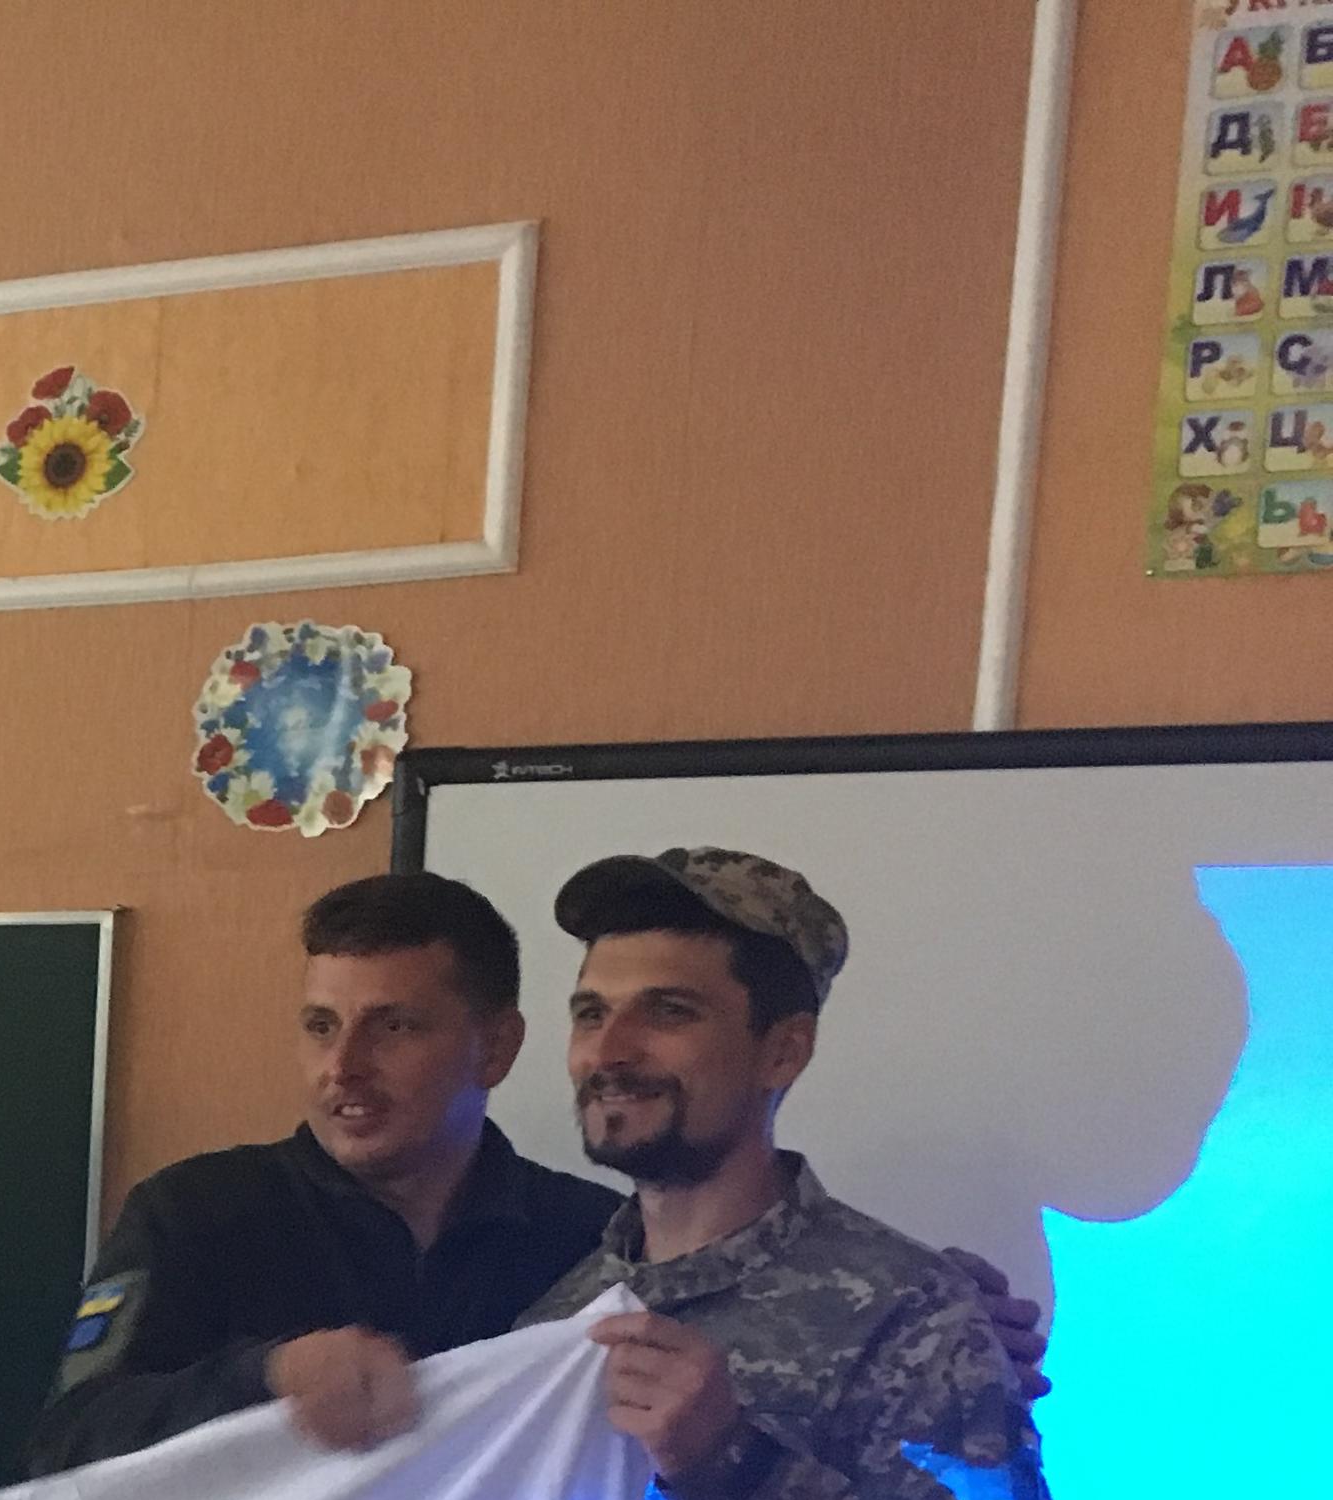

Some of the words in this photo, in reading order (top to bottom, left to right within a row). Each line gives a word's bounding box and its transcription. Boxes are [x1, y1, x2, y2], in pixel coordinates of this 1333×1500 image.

[1219, 36, 1255, 73] А
[1210, 111, 1252, 158] Д
[1204, 189, 1241, 226] И
[1197, 263, 1235, 302] Л
[1190, 340, 1223, 378] Р
[1184, 415, 1221, 454] Х
[1269, 409, 1308, 453] Ц
